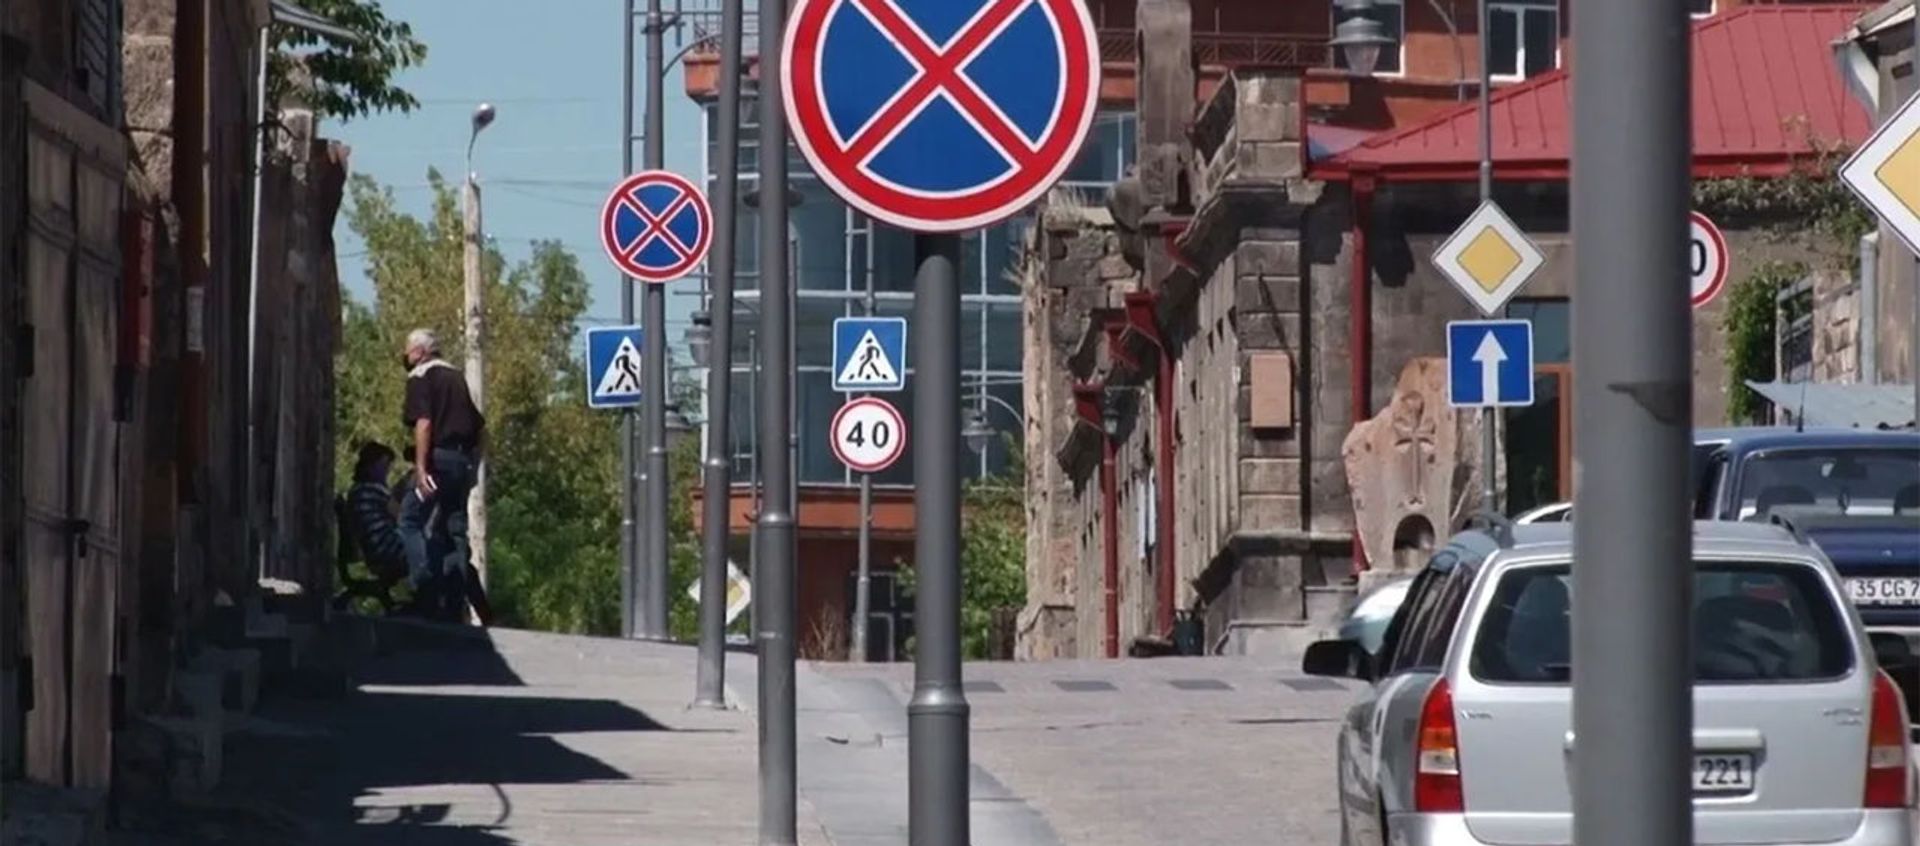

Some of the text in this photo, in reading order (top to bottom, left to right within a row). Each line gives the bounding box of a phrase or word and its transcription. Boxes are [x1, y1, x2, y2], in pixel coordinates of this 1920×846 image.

[1691, 238, 1707, 277] 0
[846, 420, 889, 448] 40
[1856, 579, 1876, 597] 35
[1881, 579, 1906, 597] CG
[1699, 758, 1743, 785] 221
